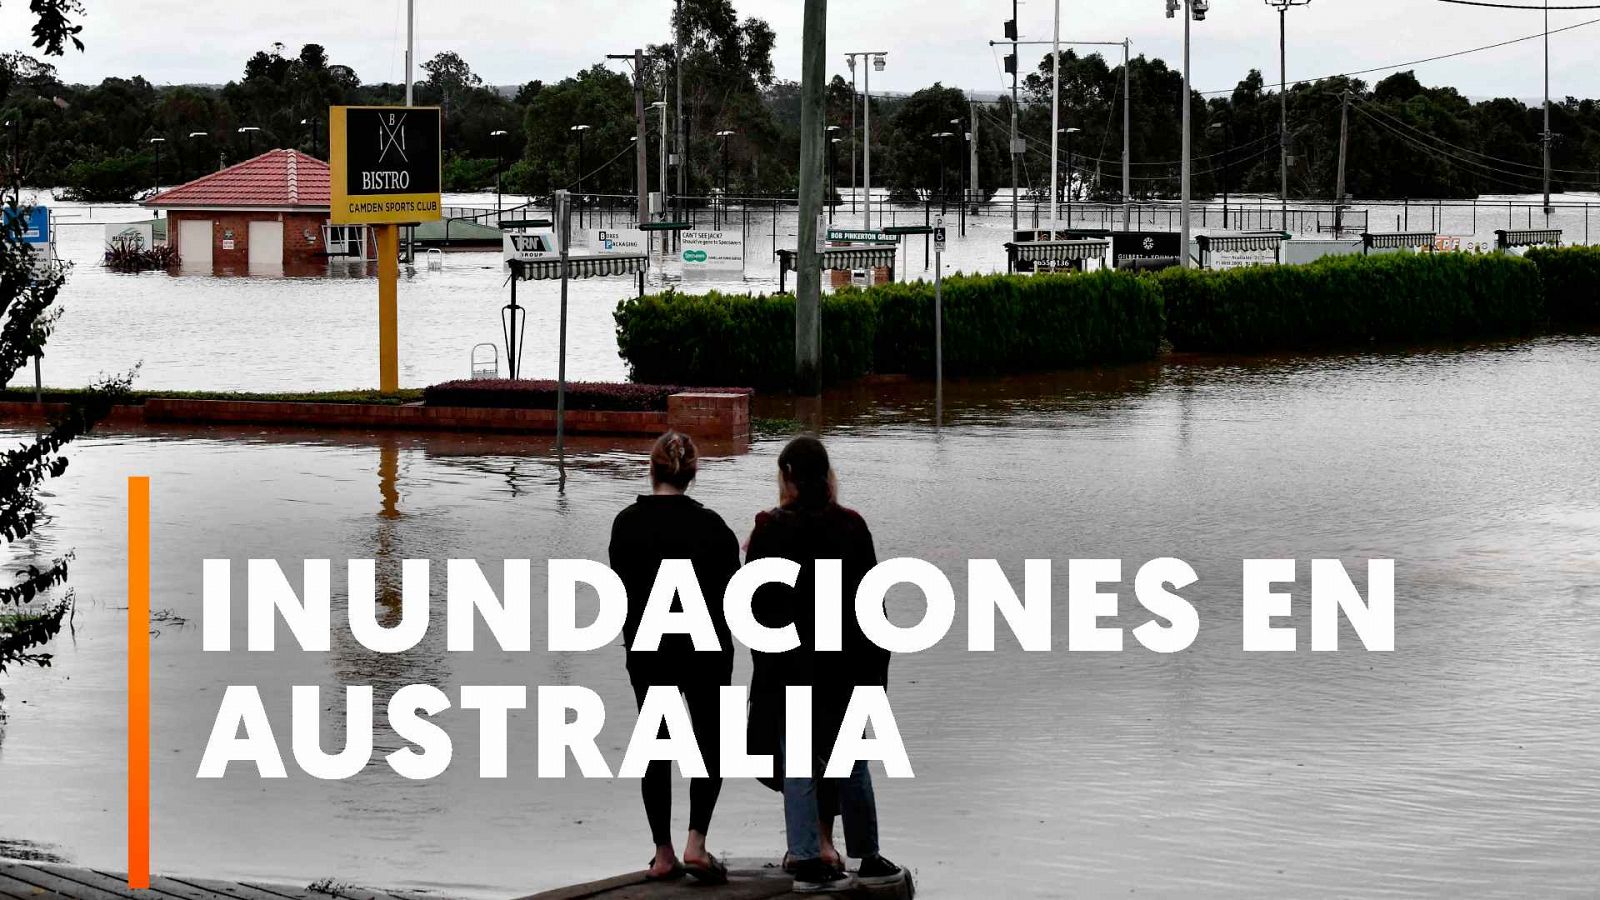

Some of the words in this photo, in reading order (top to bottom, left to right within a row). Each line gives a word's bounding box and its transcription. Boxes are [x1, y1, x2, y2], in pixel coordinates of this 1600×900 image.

[362, 170, 410, 190] BISTRO
[349, 203, 384, 213] CAMDEN
[385, 202, 415, 212] SPORTS
[417, 201, 437, 211] CLUB
[844, 232, 876, 240] PINKERTON
